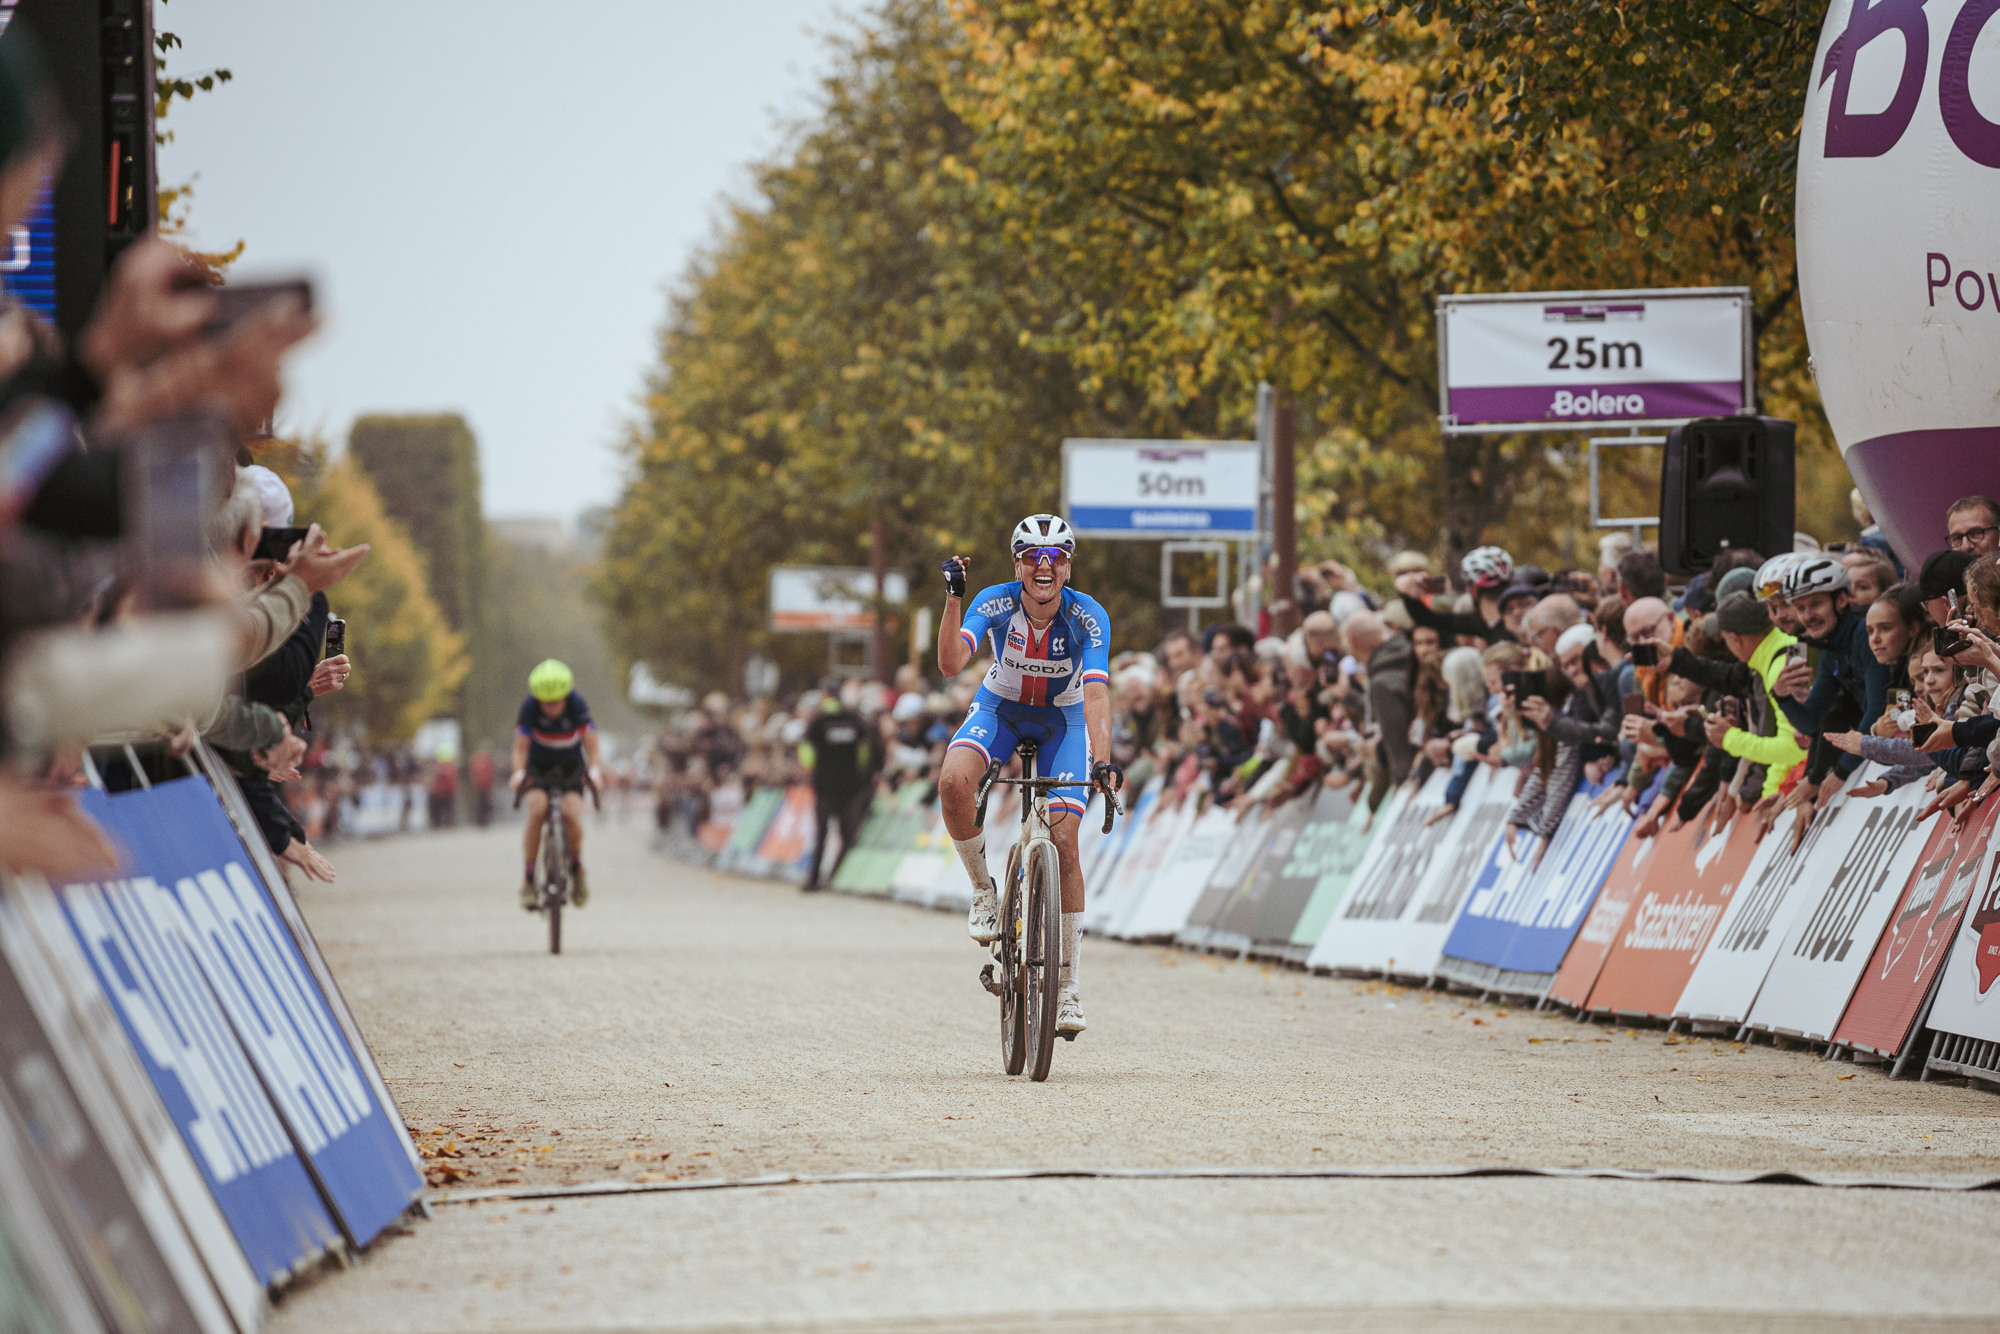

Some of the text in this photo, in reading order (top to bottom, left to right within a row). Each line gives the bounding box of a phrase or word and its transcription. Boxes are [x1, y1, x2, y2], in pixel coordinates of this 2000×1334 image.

[1546, 336, 1643, 369] 25m
[1551, 389, 1645, 416] Bolero
[1138, 472, 1206, 495] 50m
[1793, 805, 1924, 962] ROSE
